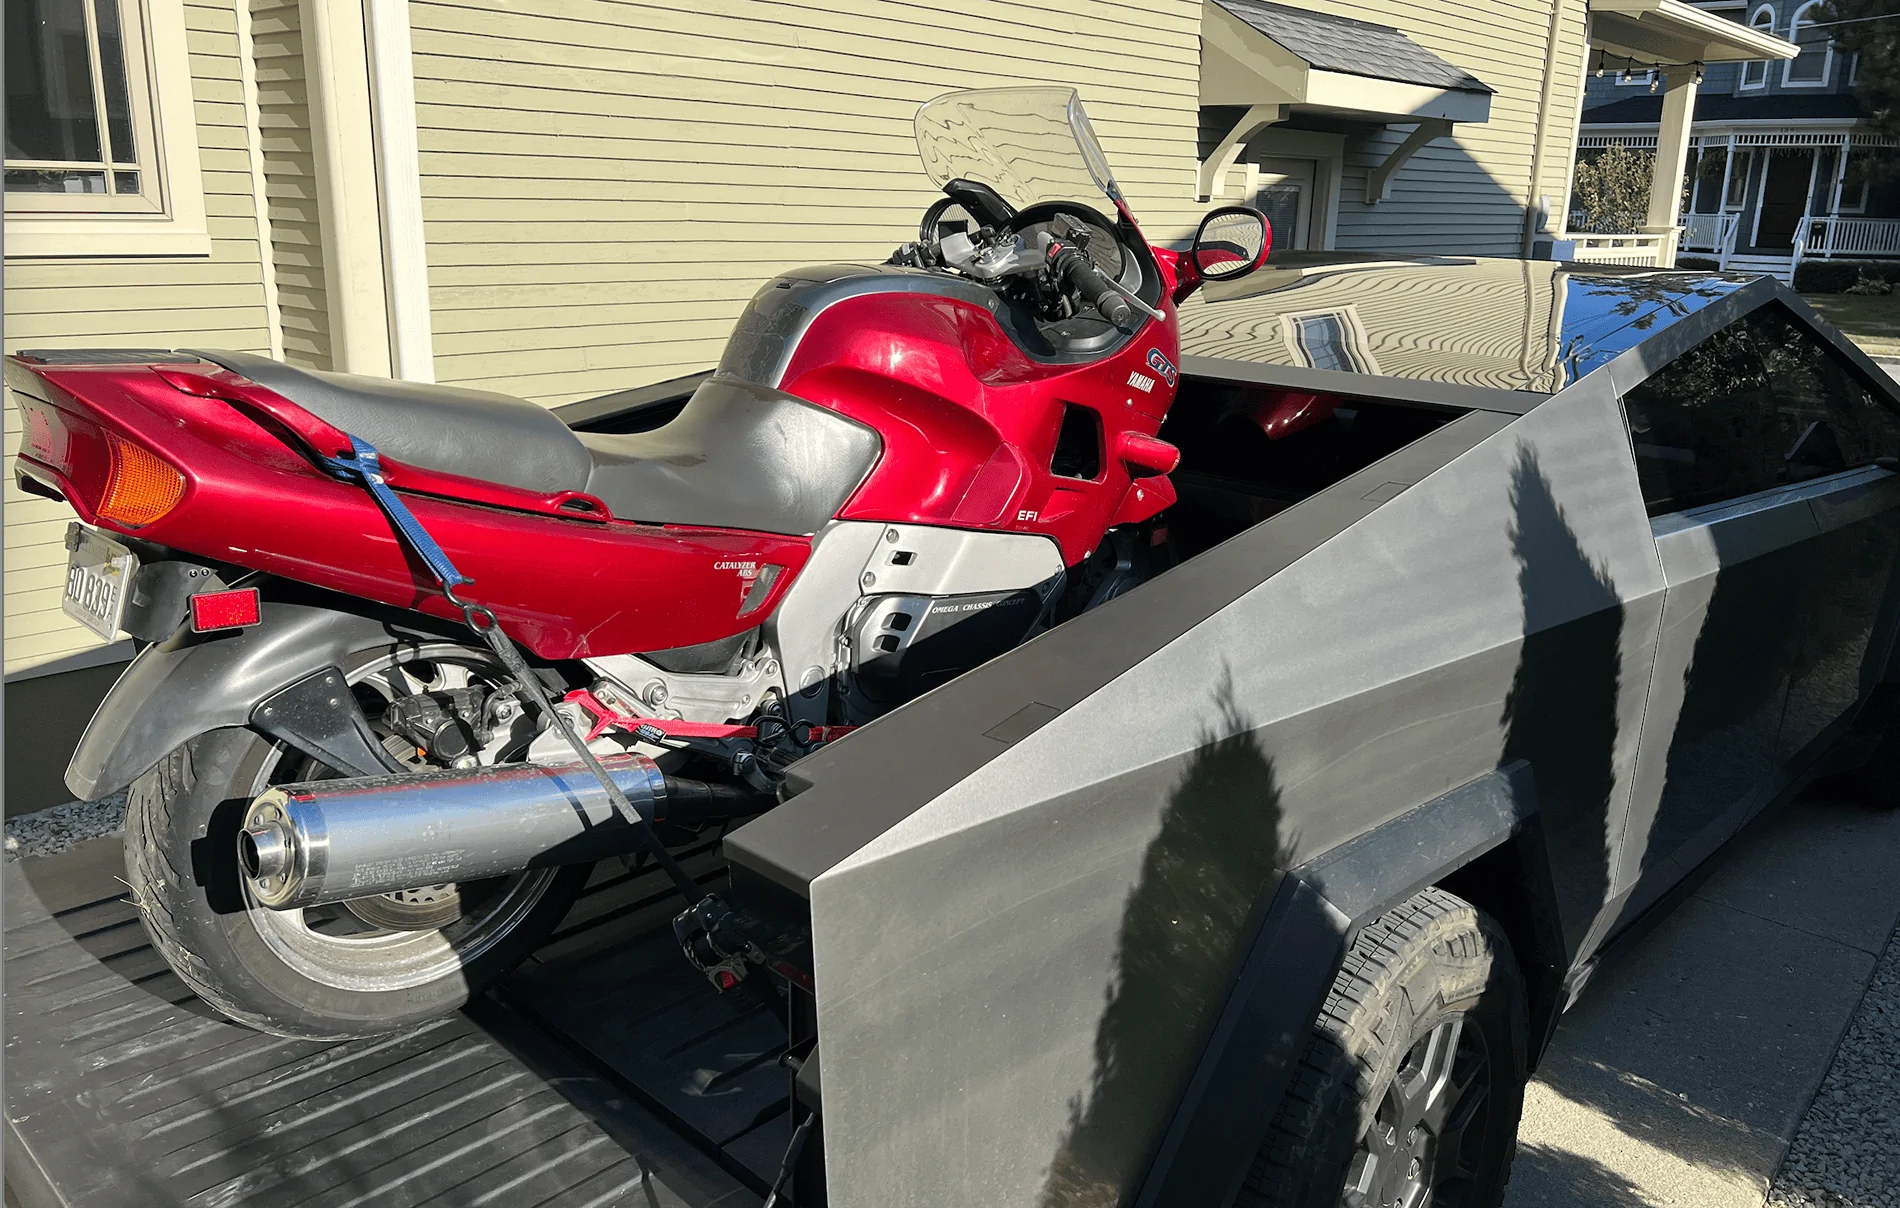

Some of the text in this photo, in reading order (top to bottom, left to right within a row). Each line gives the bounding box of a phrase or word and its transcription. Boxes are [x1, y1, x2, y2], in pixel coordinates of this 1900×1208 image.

[1146, 348, 1178, 387] GTS
[1126, 371, 1155, 393] YAMAHA
[1017, 510, 1038, 521] EFI
[714, 561, 756, 570] CATALYZER
[737, 569, 752, 577] ABS
[931, 598, 1025, 614] OMEGA CHASSIS CONCEPT
